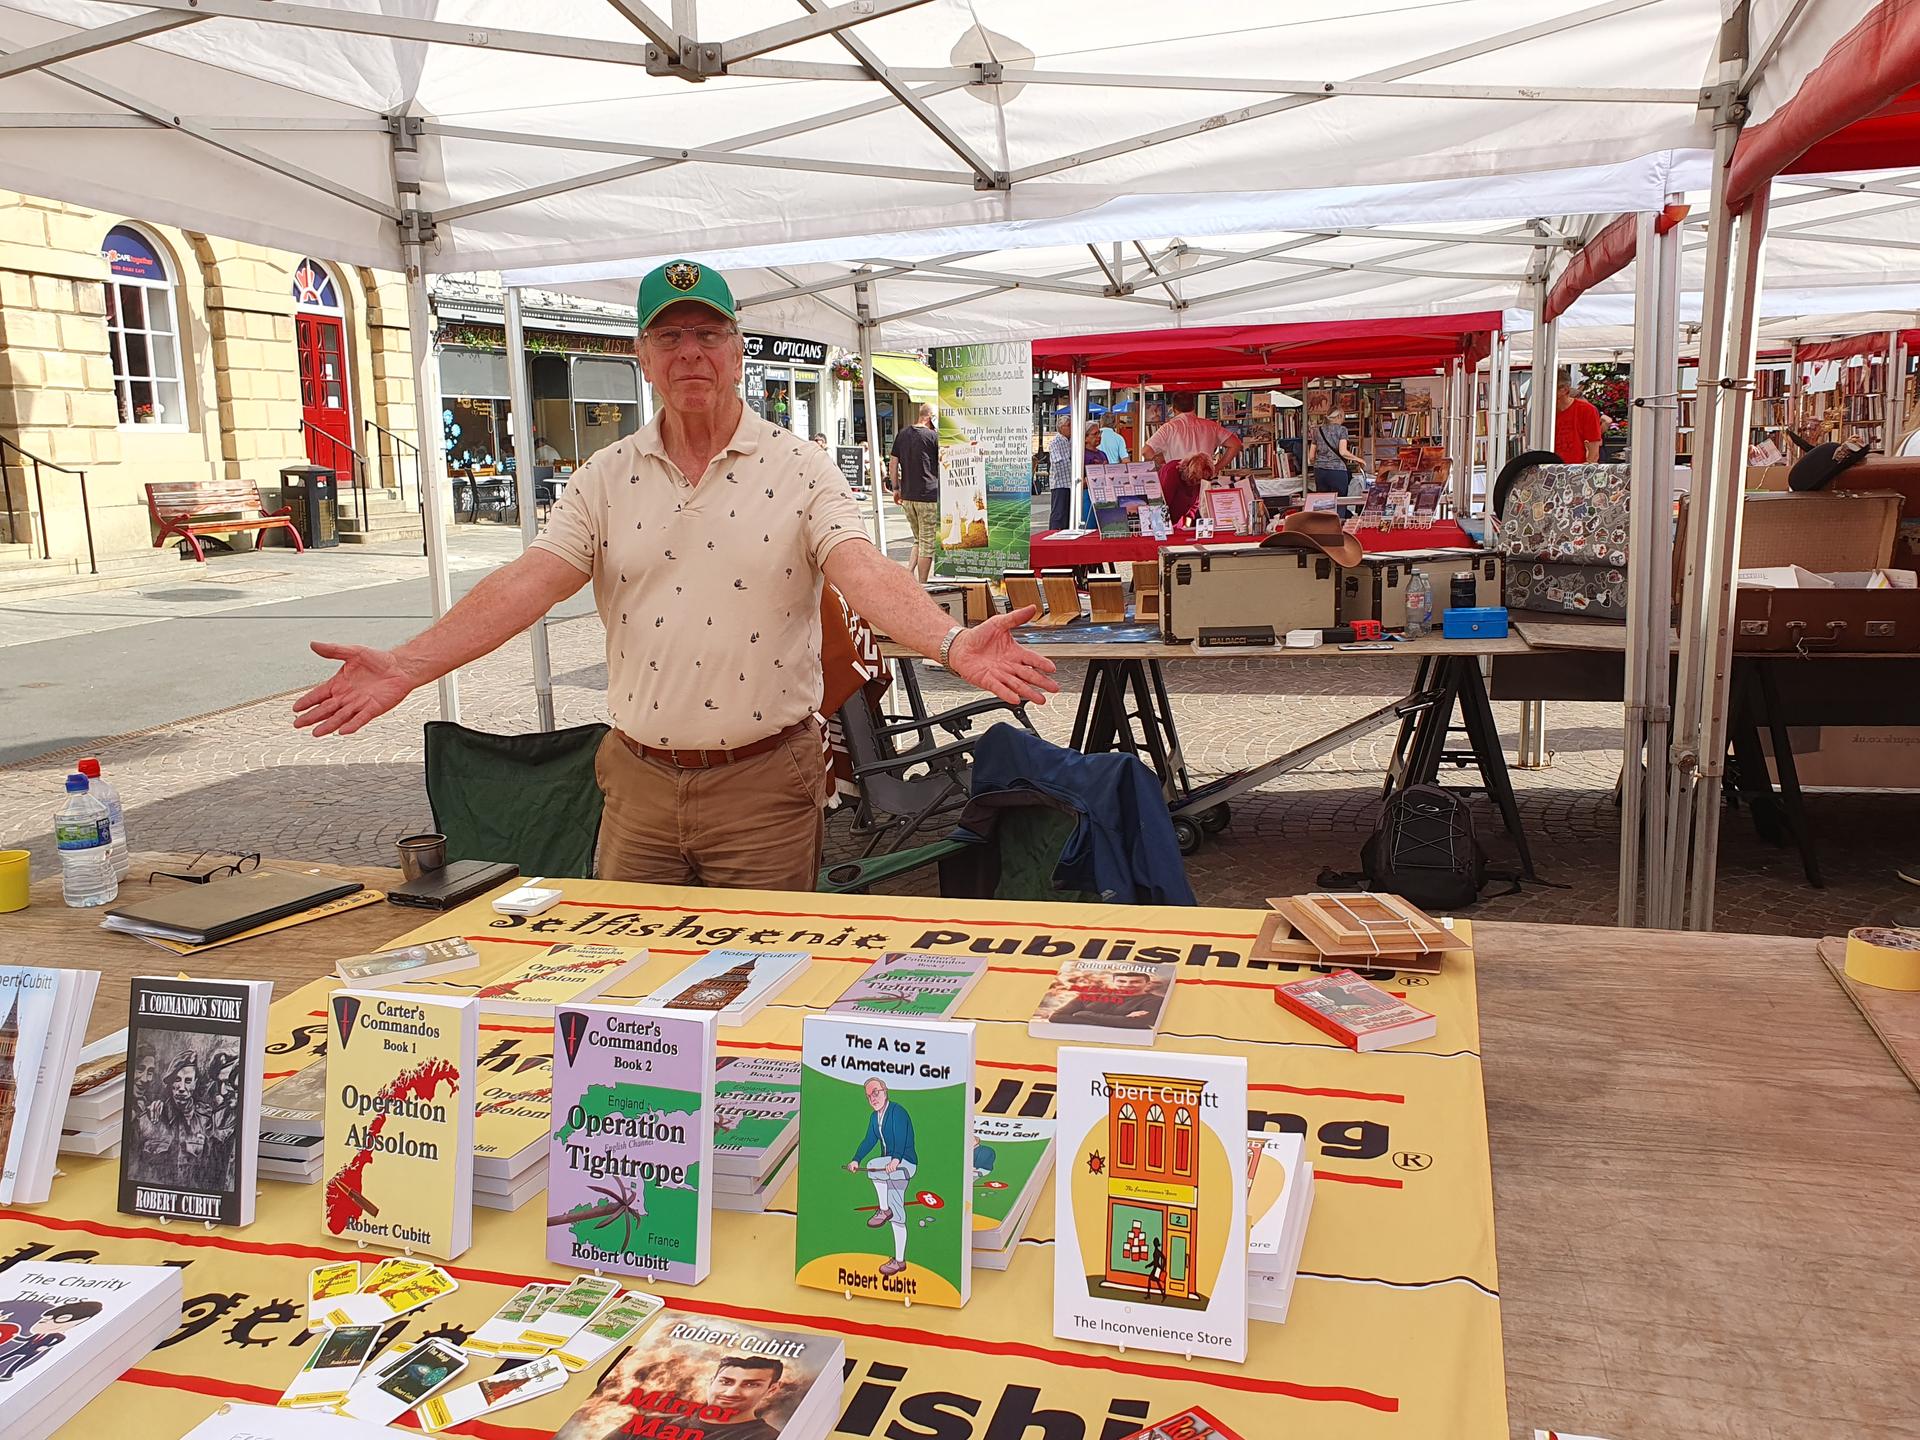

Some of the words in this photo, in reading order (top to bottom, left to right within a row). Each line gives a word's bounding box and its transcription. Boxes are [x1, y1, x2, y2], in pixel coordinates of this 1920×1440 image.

[773, 340, 822, 359] OPTICIANS
[967, 341, 1028, 366] MALONE
[941, 408, 956, 417] THE
[957, 406, 1001, 416] WINTERNE
[1002, 405, 1031, 415] SERIES
[967, 426, 984, 435] really
[986, 426, 1003, 434] loved
[1004, 426, 1015, 434] the
[1016, 426, 1028, 434] mix
[995, 441, 1006, 449] and
[1005, 447, 1028, 455] hooked
[951, 457, 970, 469] FROM
[949, 466, 976, 478] KNIGHT
[488, 911, 888, 951] Selfishgenie
[761, 951, 798, 959] Cubitt
[903, 956, 966, 965] Commandos
[528, 963, 606, 975] Operation
[1075, 962, 1117, 970] Robert
[1119, 964, 1158, 973] Cubitt
[22, 972, 53, 990] Cubitt
[515, 972, 588, 984] Absolom
[873, 972, 959, 985] Operation
[866, 981, 951, 994] Tightrope
[138, 993, 147, 1012] A
[149, 994, 208, 1017] COMMANDO'S
[210, 999, 242, 1019] STORY
[377, 1000, 425, 1022] Carter's
[851, 1005, 887, 1014] Robert
[360, 1015, 441, 1039] Commandos
[606, 1016, 661, 1038] Carter's
[383, 1038, 409, 1053] Book
[411, 1042, 417, 1054] 1
[588, 1030, 679, 1056] Commandos
[845, 1034, 873, 1050] The
[877, 1036, 889, 1051] A
[893, 1038, 911, 1053] to
[915, 1041, 926, 1055] Z
[613, 1056, 644, 1072] Book
[645, 1060, 653, 1072] 2
[733, 1062, 801, 1074] Command
[753, 1058, 800, 1068] Carter's
[820, 1055, 838, 1068] of
[841, 1055, 915, 1077] (Amateur)
[919, 1063, 951, 1081] Golf
[750, 1071, 774, 1079] Book
[733, 1084, 767, 1092] England
[1090, 1080, 1154, 1101] Robert
[1160, 1086, 1219, 1109] Cubitt
[341, 1084, 447, 1123] Operation
[608, 1094, 645, 1111] England
[715, 1091, 797, 1104] eration
[715, 1104, 784, 1119] htrope
[567, 1104, 686, 1145] Operation
[980, 1120, 990, 1128] A
[344, 1123, 439, 1161] Absolom
[729, 1135, 760, 1143] France
[1012, 1130, 1040, 1139] Golf
[565, 1144, 684, 1187] Tightrope
[135, 1188, 178, 1213] ROBERT
[181, 1194, 222, 1217] CUBITT
[1175, 1216, 1183, 1224] 2
[346, 1216, 389, 1237] Robert
[392, 1225, 432, 1245] Cubitt
[647, 1232, 681, 1248] France
[571, 1241, 620, 1265] Robert
[623, 1250, 670, 1272] Cubitt
[19, 1272, 54, 1286] The
[58, 1276, 132, 1292] Charity
[837, 1267, 878, 1291] Robert
[882, 1273, 917, 1295] Cubitt
[1073, 1315, 1097, 1330] The
[1100, 1319, 1194, 1342] Inconvenience
[1197, 1330, 1233, 1347] Store
[669, 1322, 740, 1349] Robert
[741, 1336, 806, 1359] Cubitt
[427, 1346, 440, 1357] The
[620, 1387, 740, 1424] Mirror
